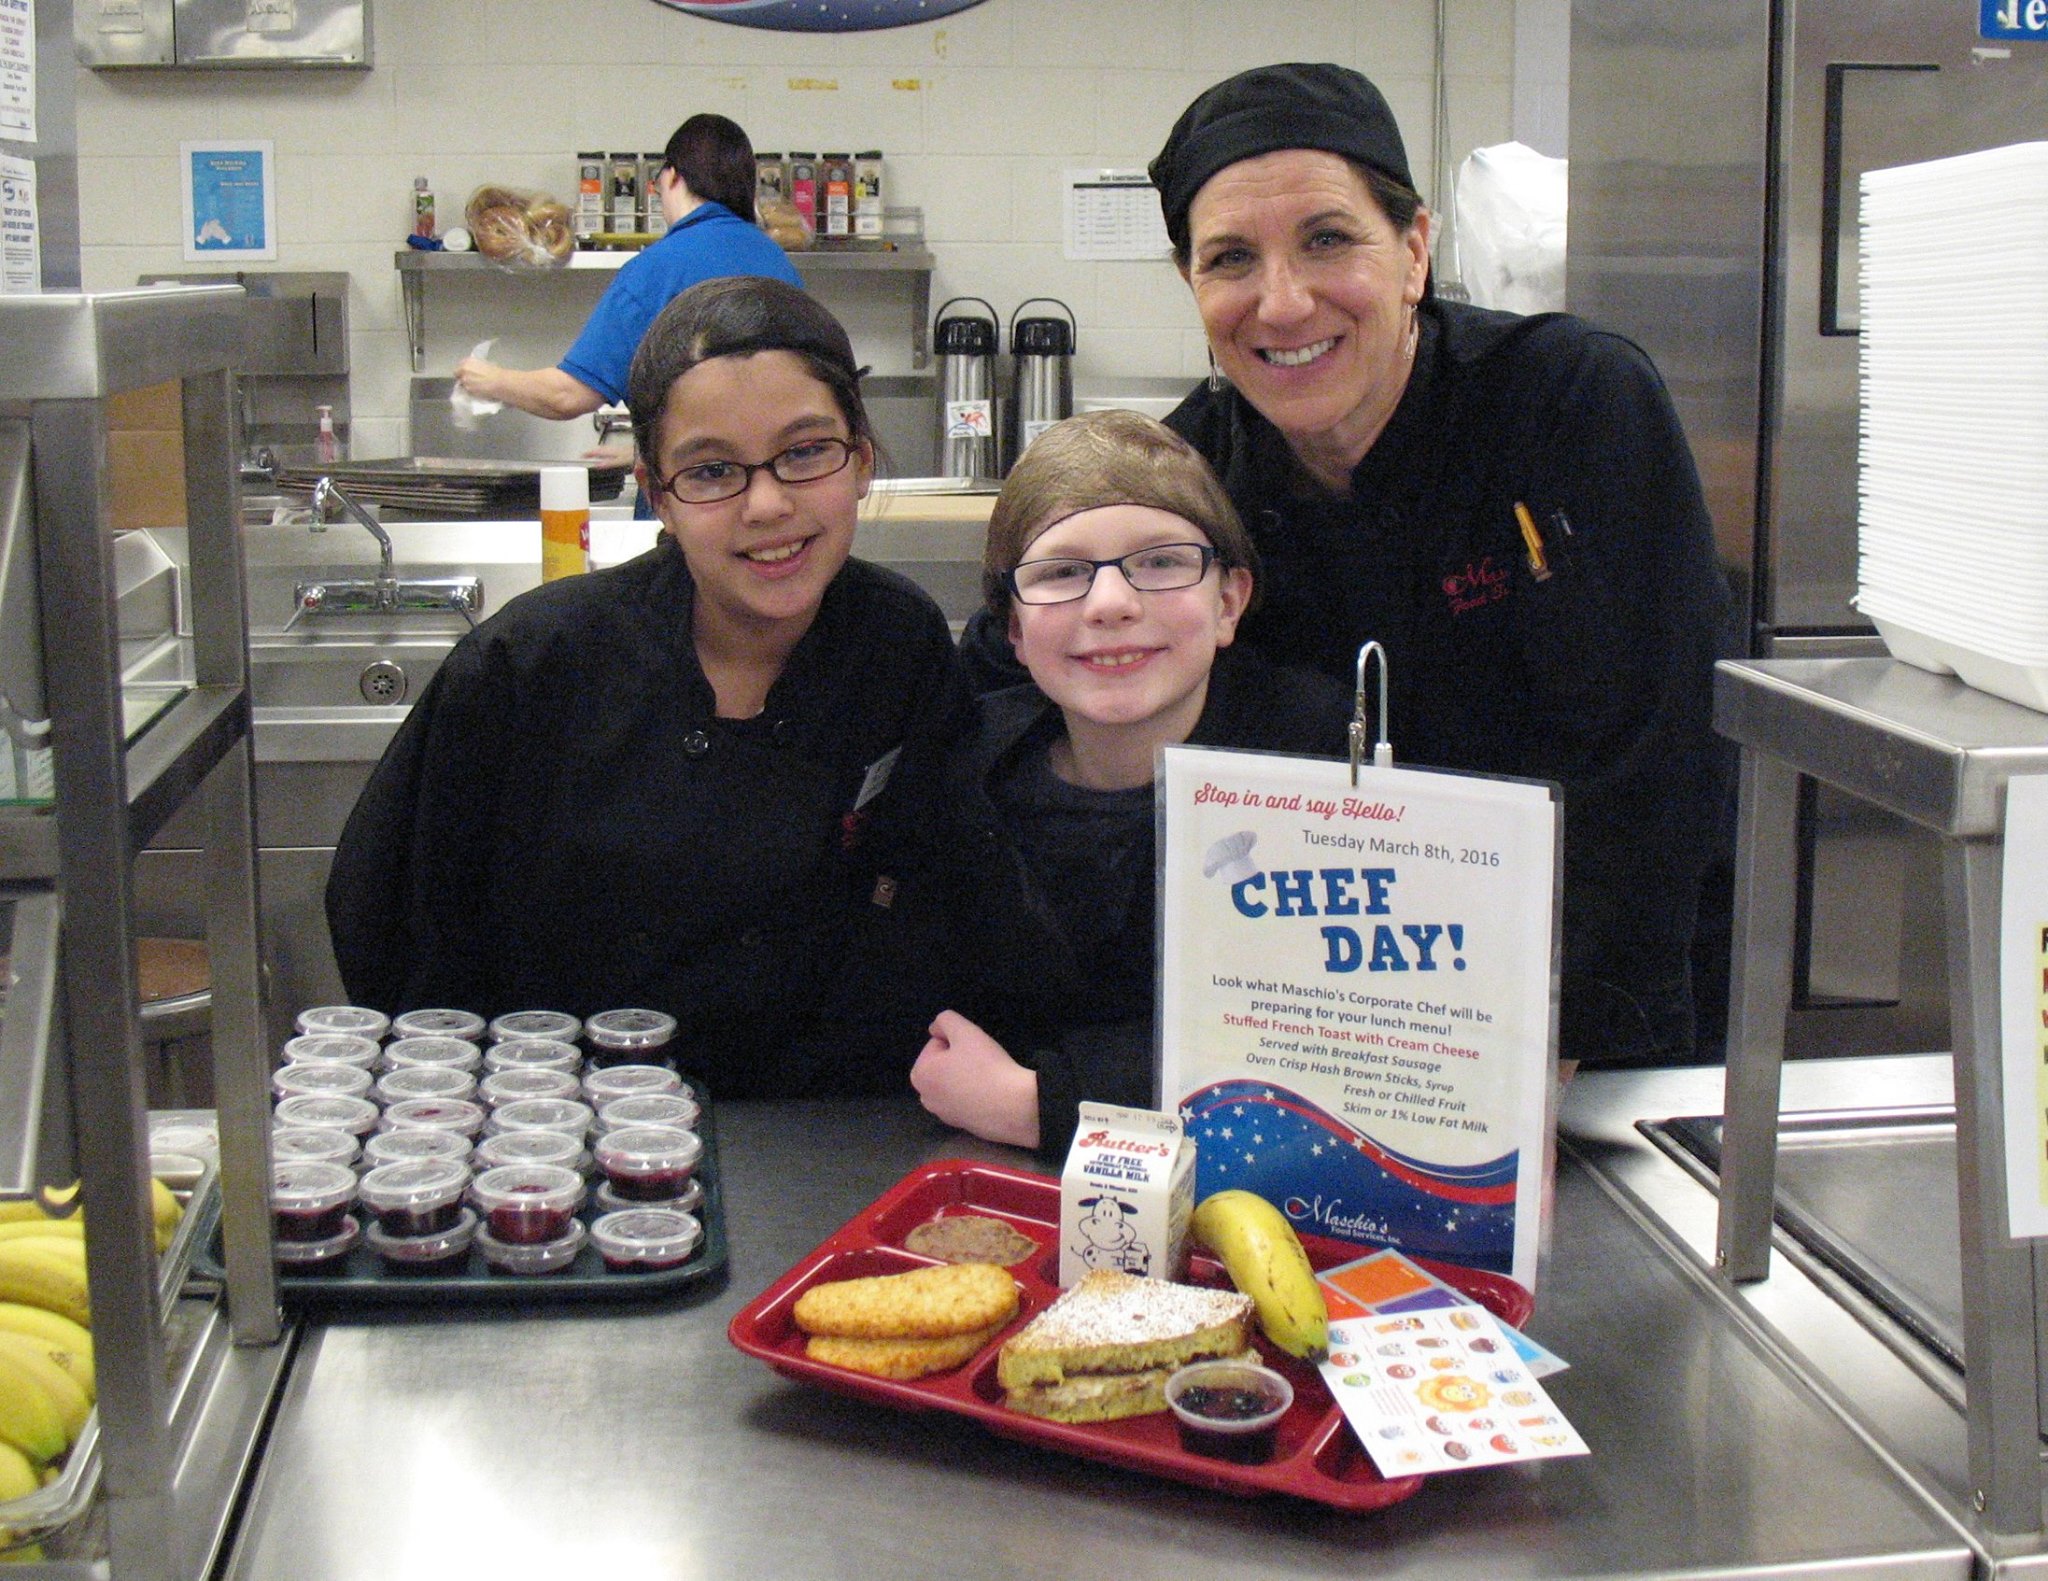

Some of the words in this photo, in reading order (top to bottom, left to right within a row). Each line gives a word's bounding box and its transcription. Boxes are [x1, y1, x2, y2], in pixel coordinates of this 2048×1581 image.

[1194, 783, 1239, 808] Stop
[1242, 789, 1262, 806] in
[1265, 794, 1302, 811] and
[1305, 799, 1338, 820] say
[1342, 798, 1406, 822] Hello!
[1302, 830, 1364, 853] Tuesday
[1370, 838, 1420, 857] March
[1424, 844, 1455, 864] 8th,
[1460, 849, 1500, 867] 2016
[1231, 868, 1397, 919] CHEF
[1320, 924, 1466, 973] DAY!
[1212, 974, 1243, 988] Look
[1246, 979, 1278, 993] what
[1282, 983, 1345, 1002] Maschio's
[1348, 992, 1413, 1011] Corporate
[1416, 1001, 1447, 1016] Chef
[1450, 1007, 1473, 1020] will
[1476, 1010, 1493, 1024] be
[1251, 1000, 1312, 1019] preparing
[1316, 1006, 1334, 1020] for
[1338, 1012, 1367, 1024] your
[1370, 1014, 1406, 1030] lunch
[1410, 1021, 1452, 1036] menu!
[1223, 1013, 1268, 1030] Stuffed
[1272, 1020, 1314, 1036] French
[1318, 1026, 1352, 1042] Toast
[1355, 1032, 1384, 1046] with
[1387, 1036, 1429, 1052] Cream
[1432, 1042, 1480, 1060] Cheese
[1259, 1036, 1299, 1052] Served
[1302, 1043, 1328, 1056] with
[1331, 1047, 1388, 1064] Breakfast
[1392, 1055, 1442, 1074] Sausage
[1246, 1052, 1276, 1066] Oven
[1279, 1057, 1308, 1072] Crisp
[1310, 1062, 1340, 1076] Hash
[1343, 1066, 1382, 1081] Brown
[1385, 1072, 1422, 1089] Sticks,
[1425, 1080, 1454, 1094] Syrup
[1343, 1084, 1376, 1098] Fresh
[1378, 1090, 1392, 1100] or
[1394, 1091, 1436, 1108] Chilled
[1438, 1099, 1466, 1112] Fruit
[1343, 1102, 1372, 1116] Skim
[1374, 1107, 1388, 1118] or
[1391, 1109, 1408, 1121] 1%
[1412, 1112, 1437, 1124] Low
[1438, 1116, 1458, 1129] Fat
[1461, 1120, 1489, 1134] Milk
[1083, 1164, 1122, 1178] VANILLA
[1126, 1171, 1150, 1183] MILK
[1097, 1153, 1116, 1163] FAT
[1118, 1156, 1144, 1167] FREE
[1285, 1194, 1388, 1234] Maschio's
[1331, 1225, 1352, 1236] Food
